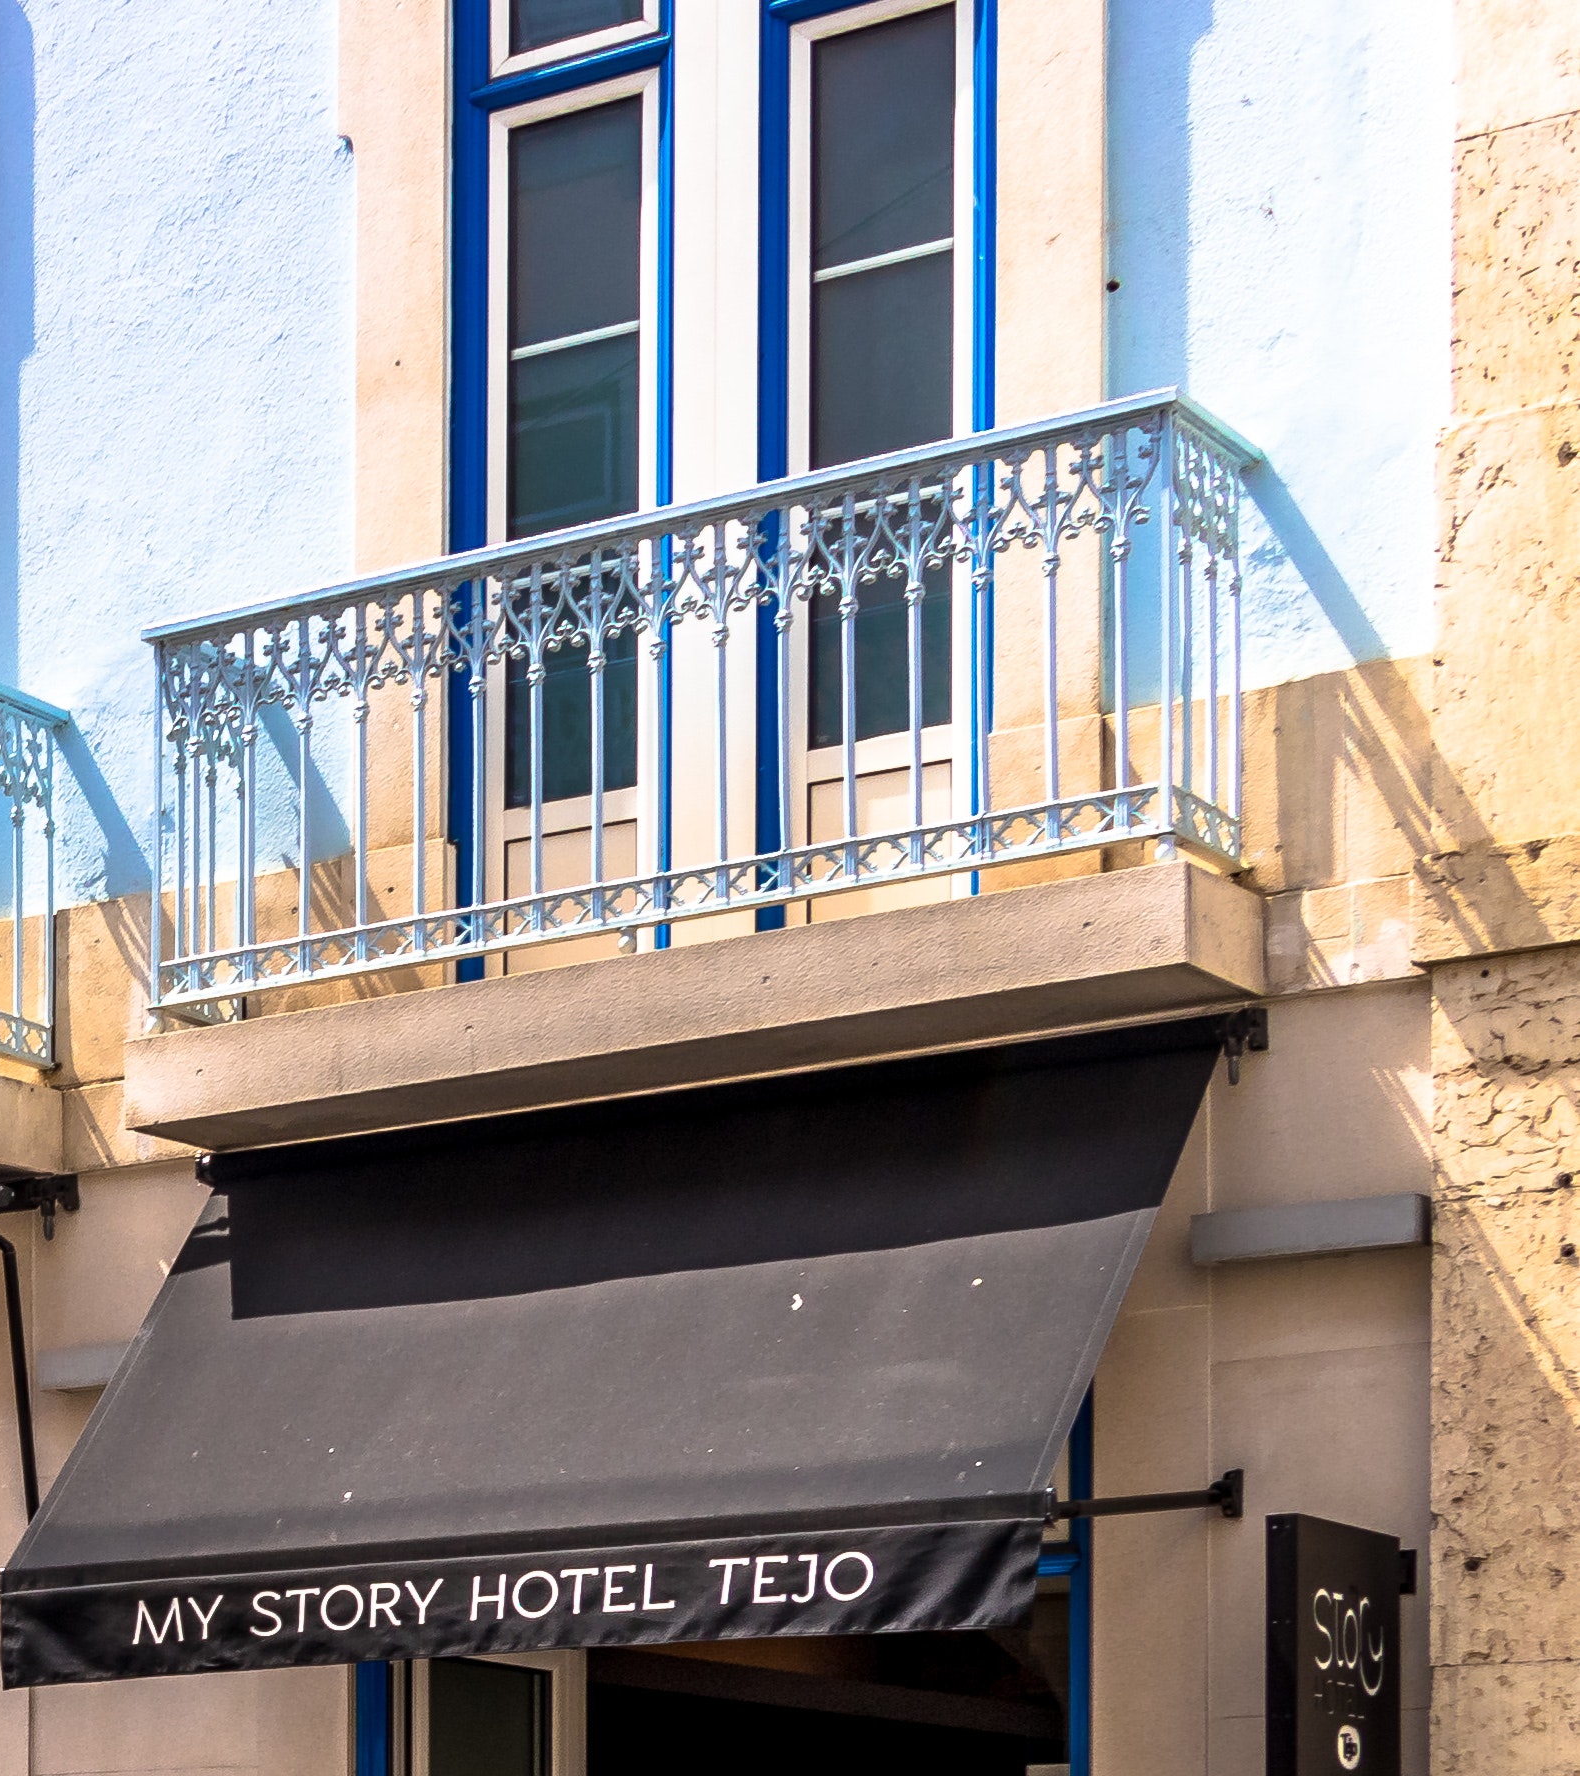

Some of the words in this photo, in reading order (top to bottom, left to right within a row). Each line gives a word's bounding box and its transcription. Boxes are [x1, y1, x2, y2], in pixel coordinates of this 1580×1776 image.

[132, 1594, 223, 1645] MY
[250, 1577, 444, 1638] STORY
[470, 1564, 675, 1622] HOTEL
[708, 1551, 874, 1606] TEJO
